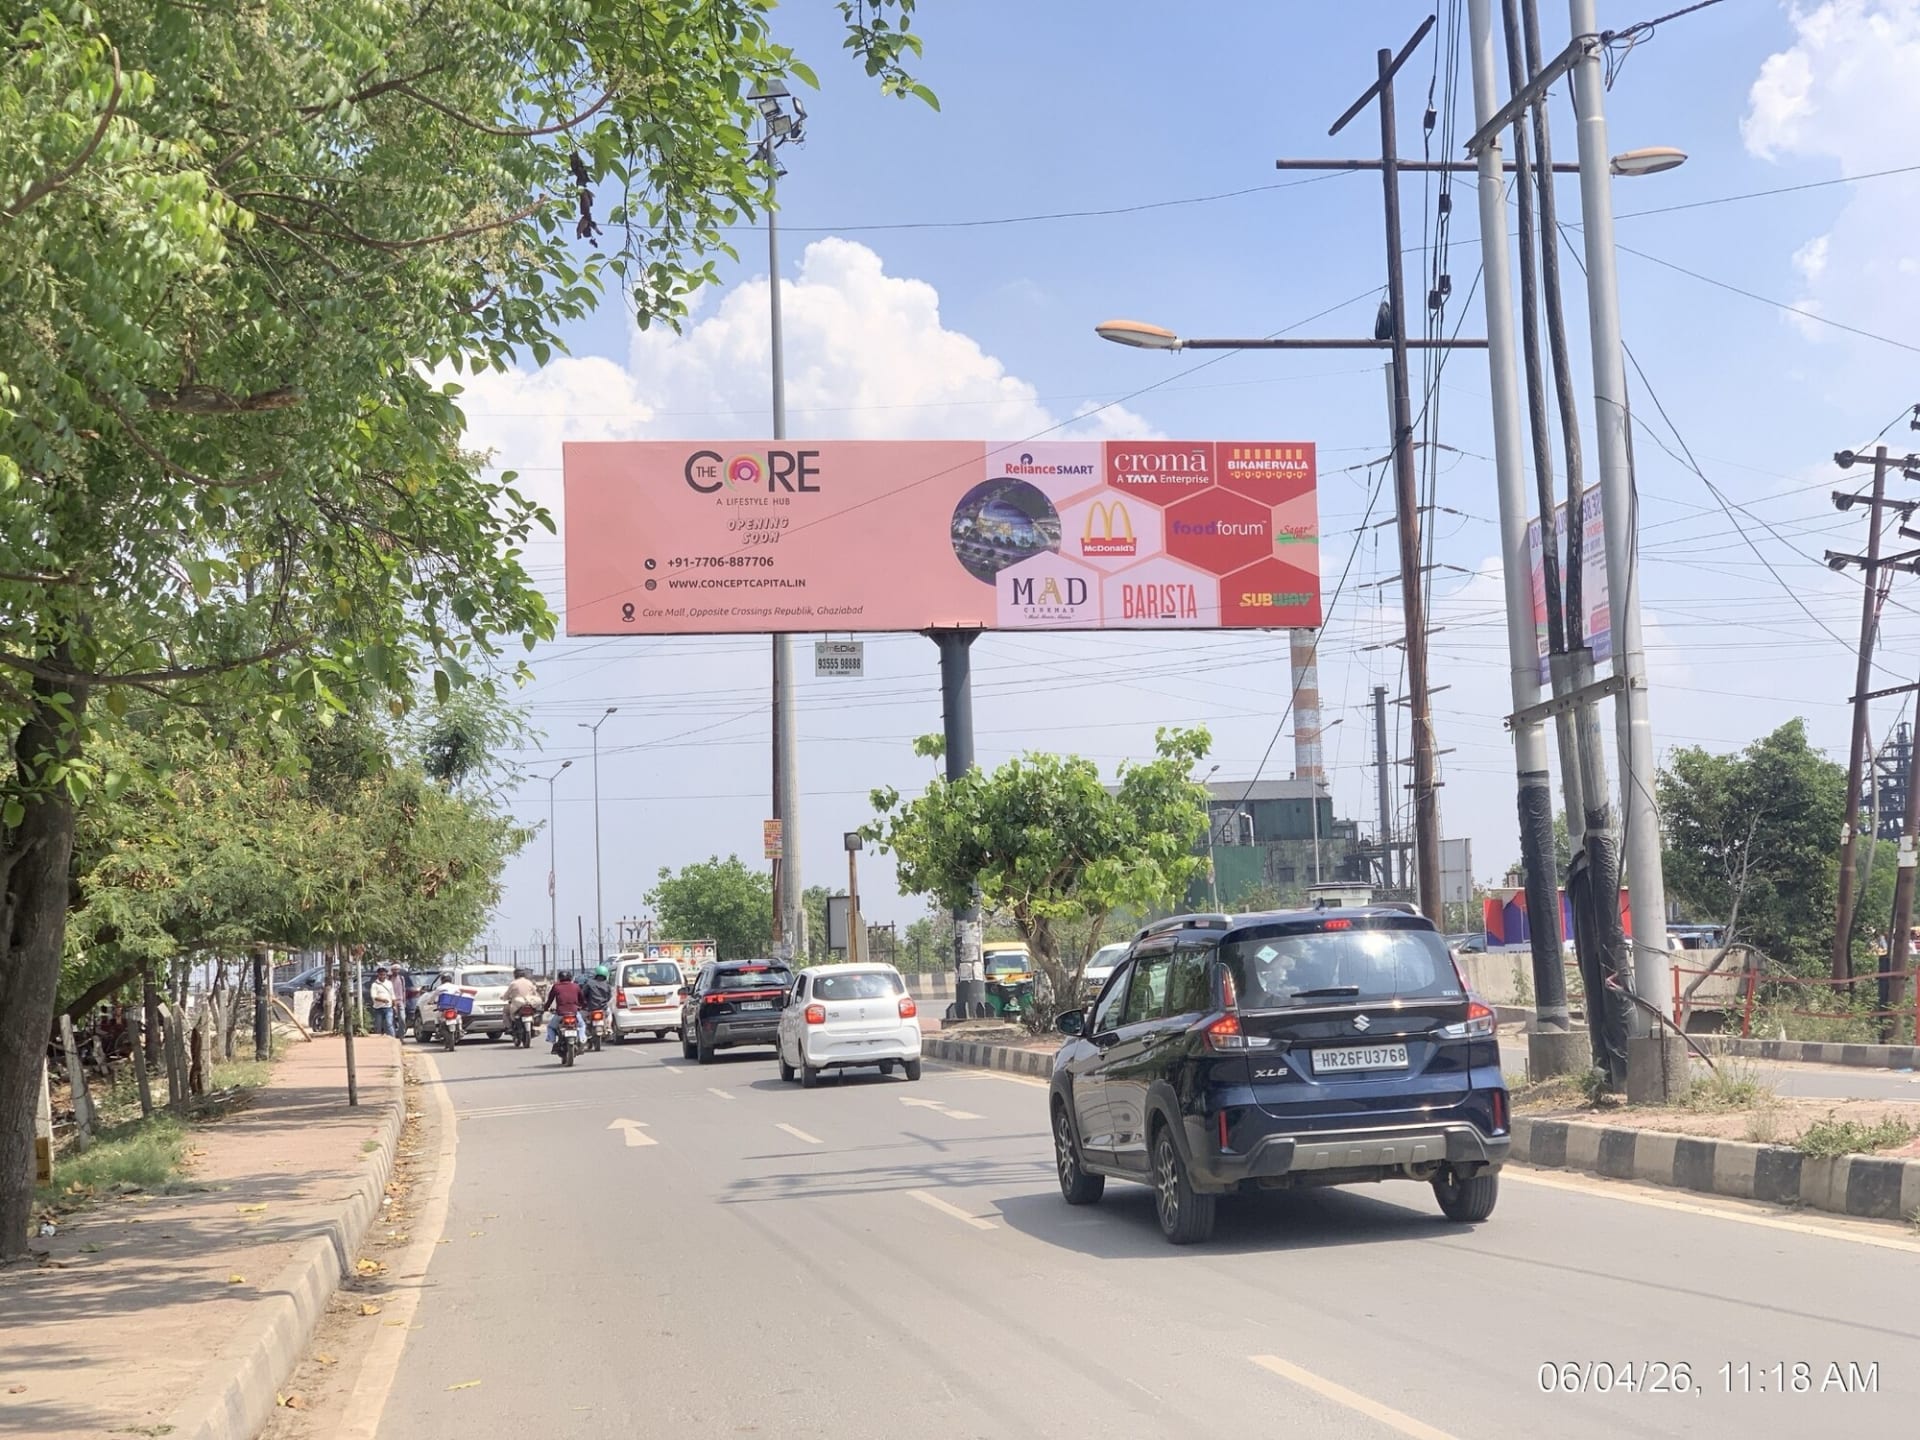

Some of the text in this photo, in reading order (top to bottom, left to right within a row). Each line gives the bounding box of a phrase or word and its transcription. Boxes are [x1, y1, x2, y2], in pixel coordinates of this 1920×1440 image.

[1228, 461, 1309, 470] BIKANERVALA
[696, 466, 717, 478] THE
[1117, 475, 1210, 485] A TATA Enterprise
[726, 498, 769, 506] LIFESTYLE
[772, 498, 791, 506] HUB
[727, 518, 790, 532] OPENING
[743, 532, 781, 544] SOON
[667, 557, 774, 568] +91-7706-887706
[668, 579, 807, 589] WWW.CONCEPTCAPITAL.IN
[1010, 577, 1088, 606] MAD
[1123, 584, 1198, 619] BARISTA
[1239, 593, 1315, 607] SUBWAY
[642, 608, 663, 617] Core
[731, 607, 773, 618] Crossings
[774, 606, 814, 616] Republik,
[817, 605, 864, 616] Ghaziabad
[1322, 1048, 1406, 1068] HR26FU3768
[1254, 1067, 1289, 1079] XL6
